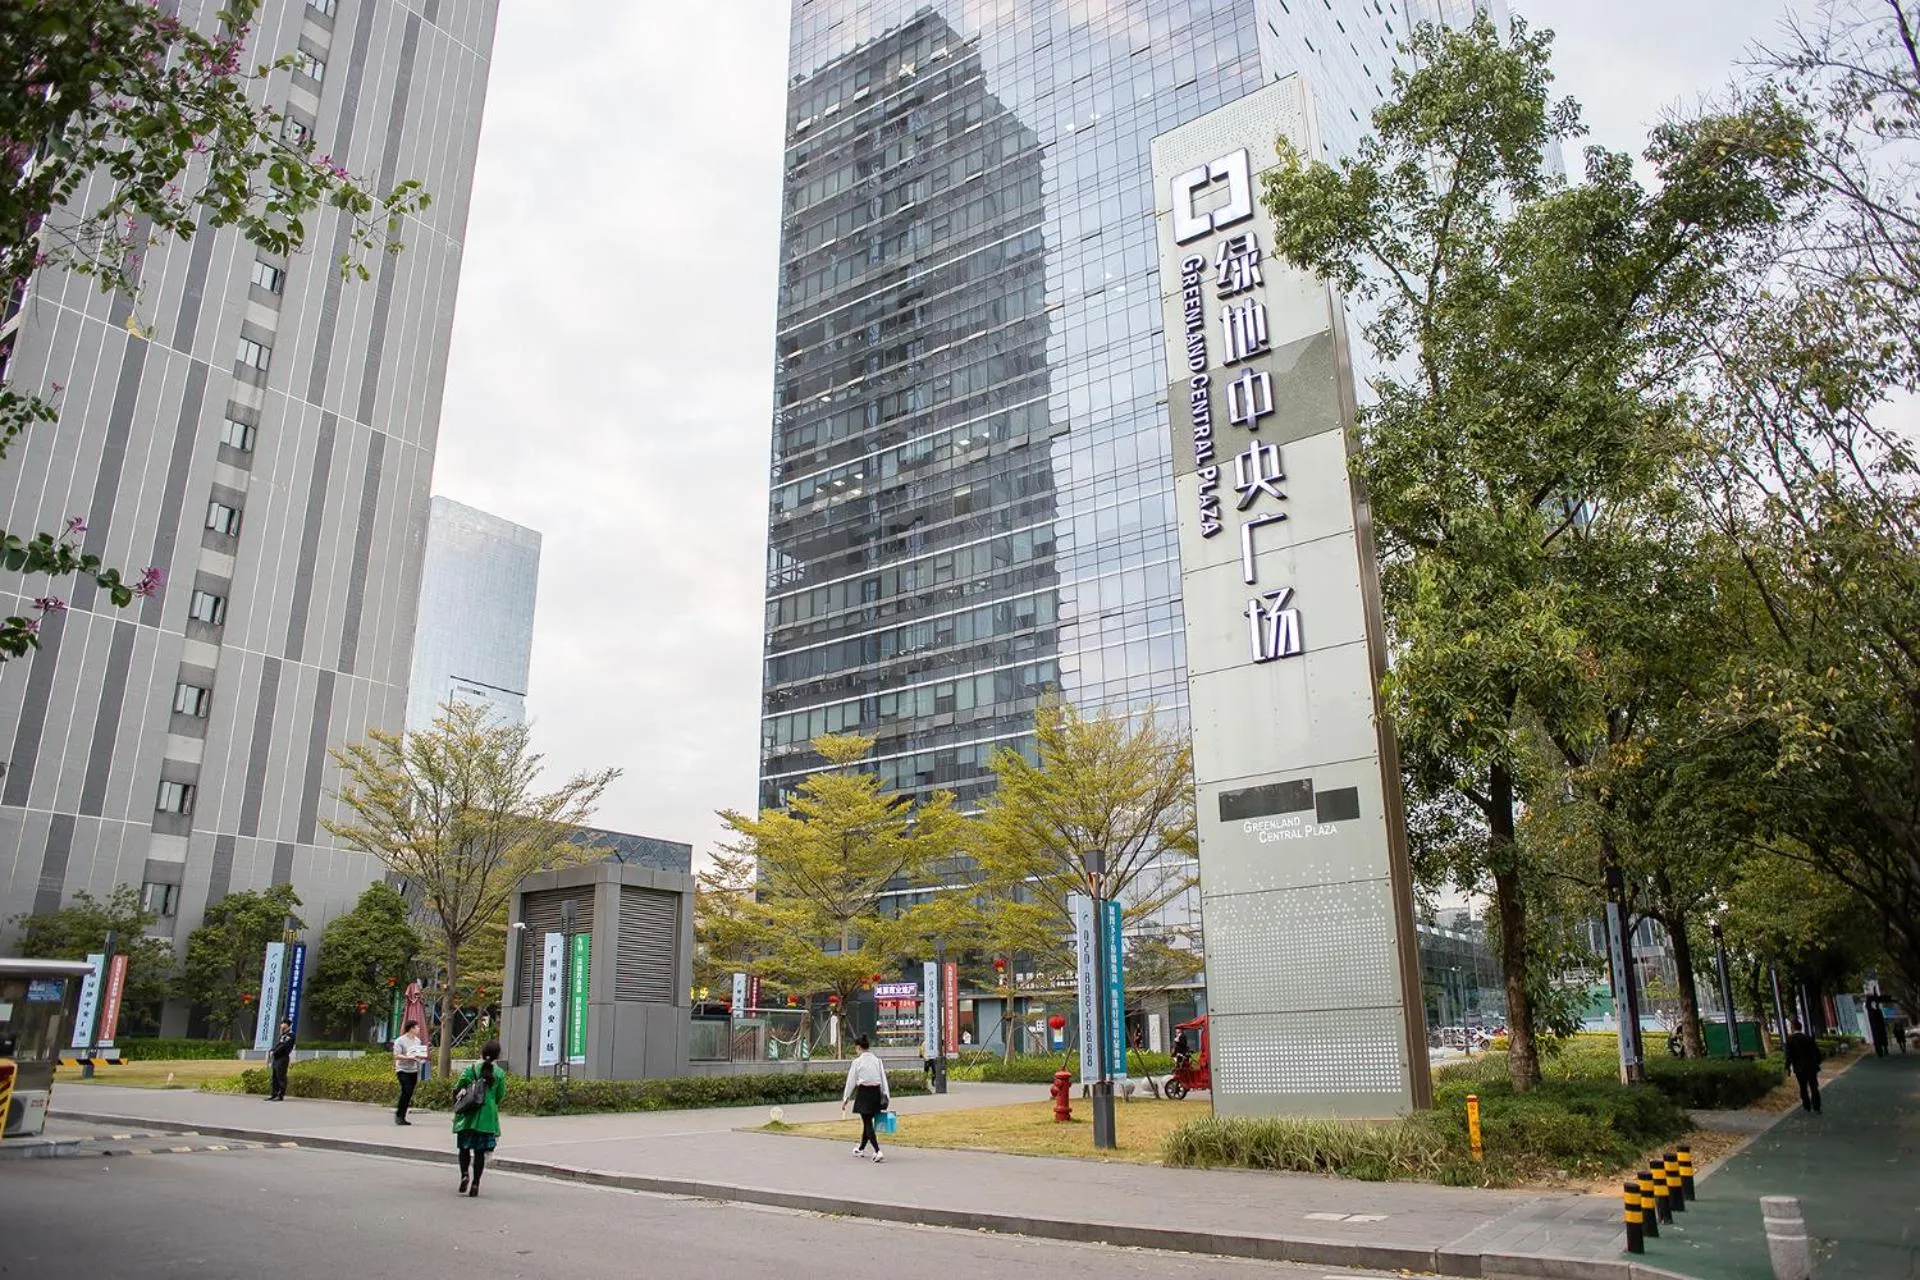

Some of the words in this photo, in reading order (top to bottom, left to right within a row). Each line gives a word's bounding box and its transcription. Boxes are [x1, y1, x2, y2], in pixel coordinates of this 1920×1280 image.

[1181, 253, 1207, 372] GREENLAND
[1189, 373, 1218, 465] CENTRAL
[1215, 231, 1303, 664] 绿地中央广场
[1197, 465, 1223, 539] PLAZA
[1243, 816, 1301, 834] GREENLAND
[1258, 827, 1305, 844] CENTRAL
[1304, 824, 1338, 838] PLAZA
